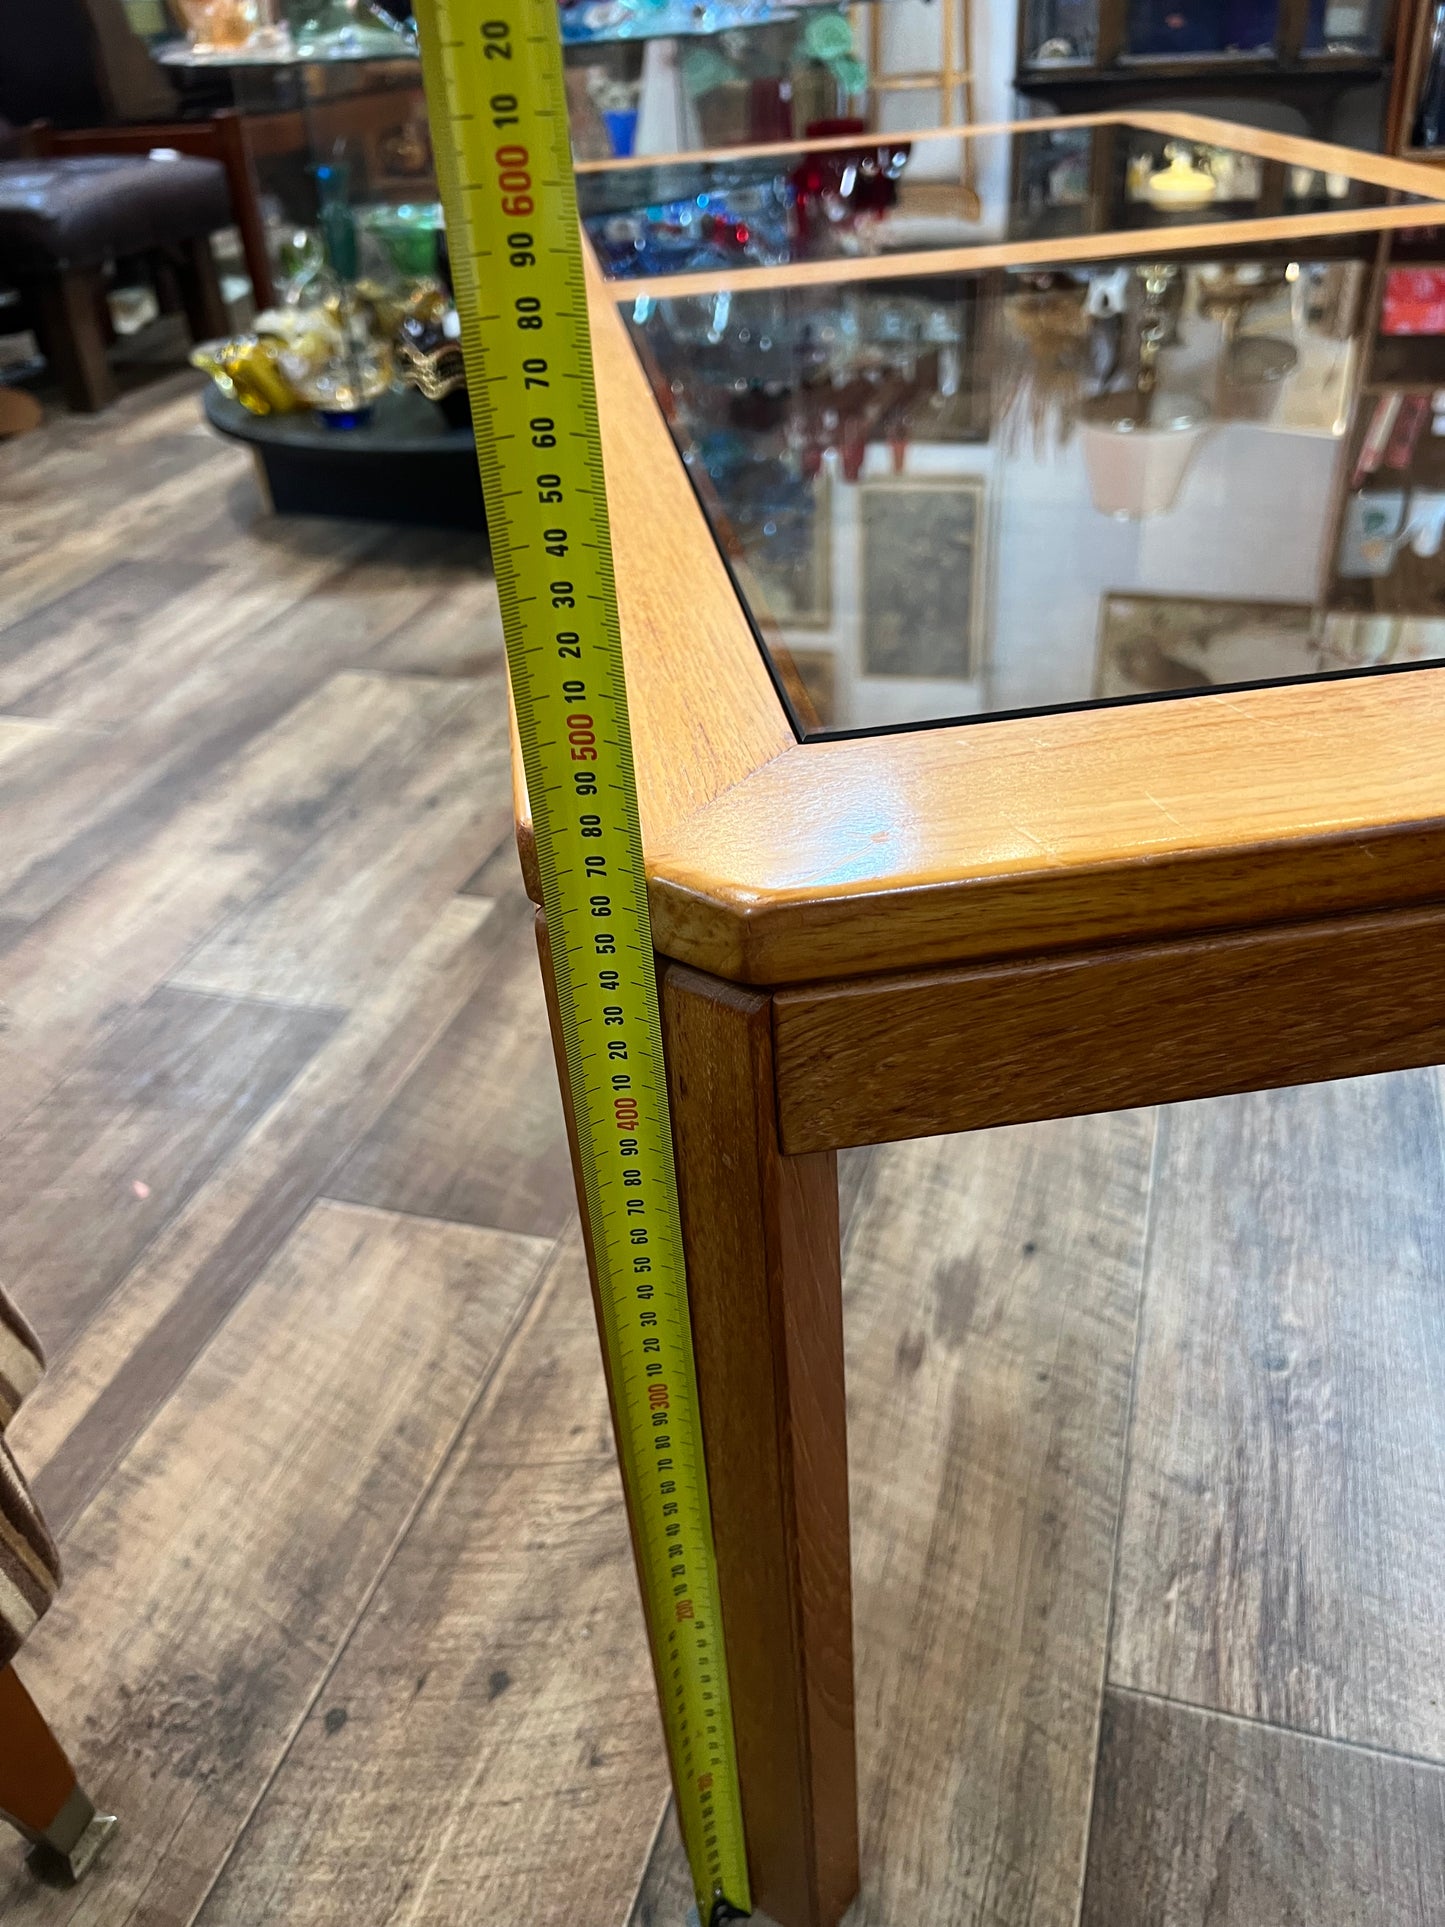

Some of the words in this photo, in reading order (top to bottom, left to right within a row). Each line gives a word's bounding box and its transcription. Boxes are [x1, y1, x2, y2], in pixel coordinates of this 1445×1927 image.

[481, 20, 512, 60] 20
[489, 94, 519, 129] 10
[495, 145, 535, 217] 600
[507, 232, 536, 267] 90
[515, 297, 543, 330] 80
[522, 358, 550, 390] 70
[530, 417, 557, 448] 60
[536, 474, 564, 504] 50
[543, 529, 569, 557] 40
[550, 582, 575, 609] 30
[556, 632, 582, 659] 20
[563, 681, 586, 703] 10
[566, 714, 598, 761] 500
[574, 772, 597, 796] 90
[580, 815, 602, 838] 80
[585, 856, 607, 877] 70
[590, 896, 612, 917] 60
[594, 934, 616, 954] 50
[599, 970, 619, 990] 40
[603, 1006, 624, 1025] 30
[607, 1041, 628, 1060] 20
[611, 1075, 631, 1091] 10
[614, 1098, 639, 1131] 400
[619, 1139, 638, 1156] 90
[623, 1170, 642, 1186] 80
[626, 1199, 645, 1216] 70
[630, 1229, 648, 1245] 60
[633, 1257, 651, 1273] 50
[636, 1285, 654, 1300] 40
[640, 1312, 657, 1327] 30
[643, 1338, 660, 1352] 20
[646, 1363, 662, 1377] 10
[648, 1384, 670, 1410] 300
[652, 1412, 668, 1426] 90
[654, 1435, 671, 1450] 80
[657, 1458, 673, 1472] 70
[660, 1480, 676, 1494] 60
[663, 1502, 678, 1517] 50
[665, 1523, 680, 1537] 40
